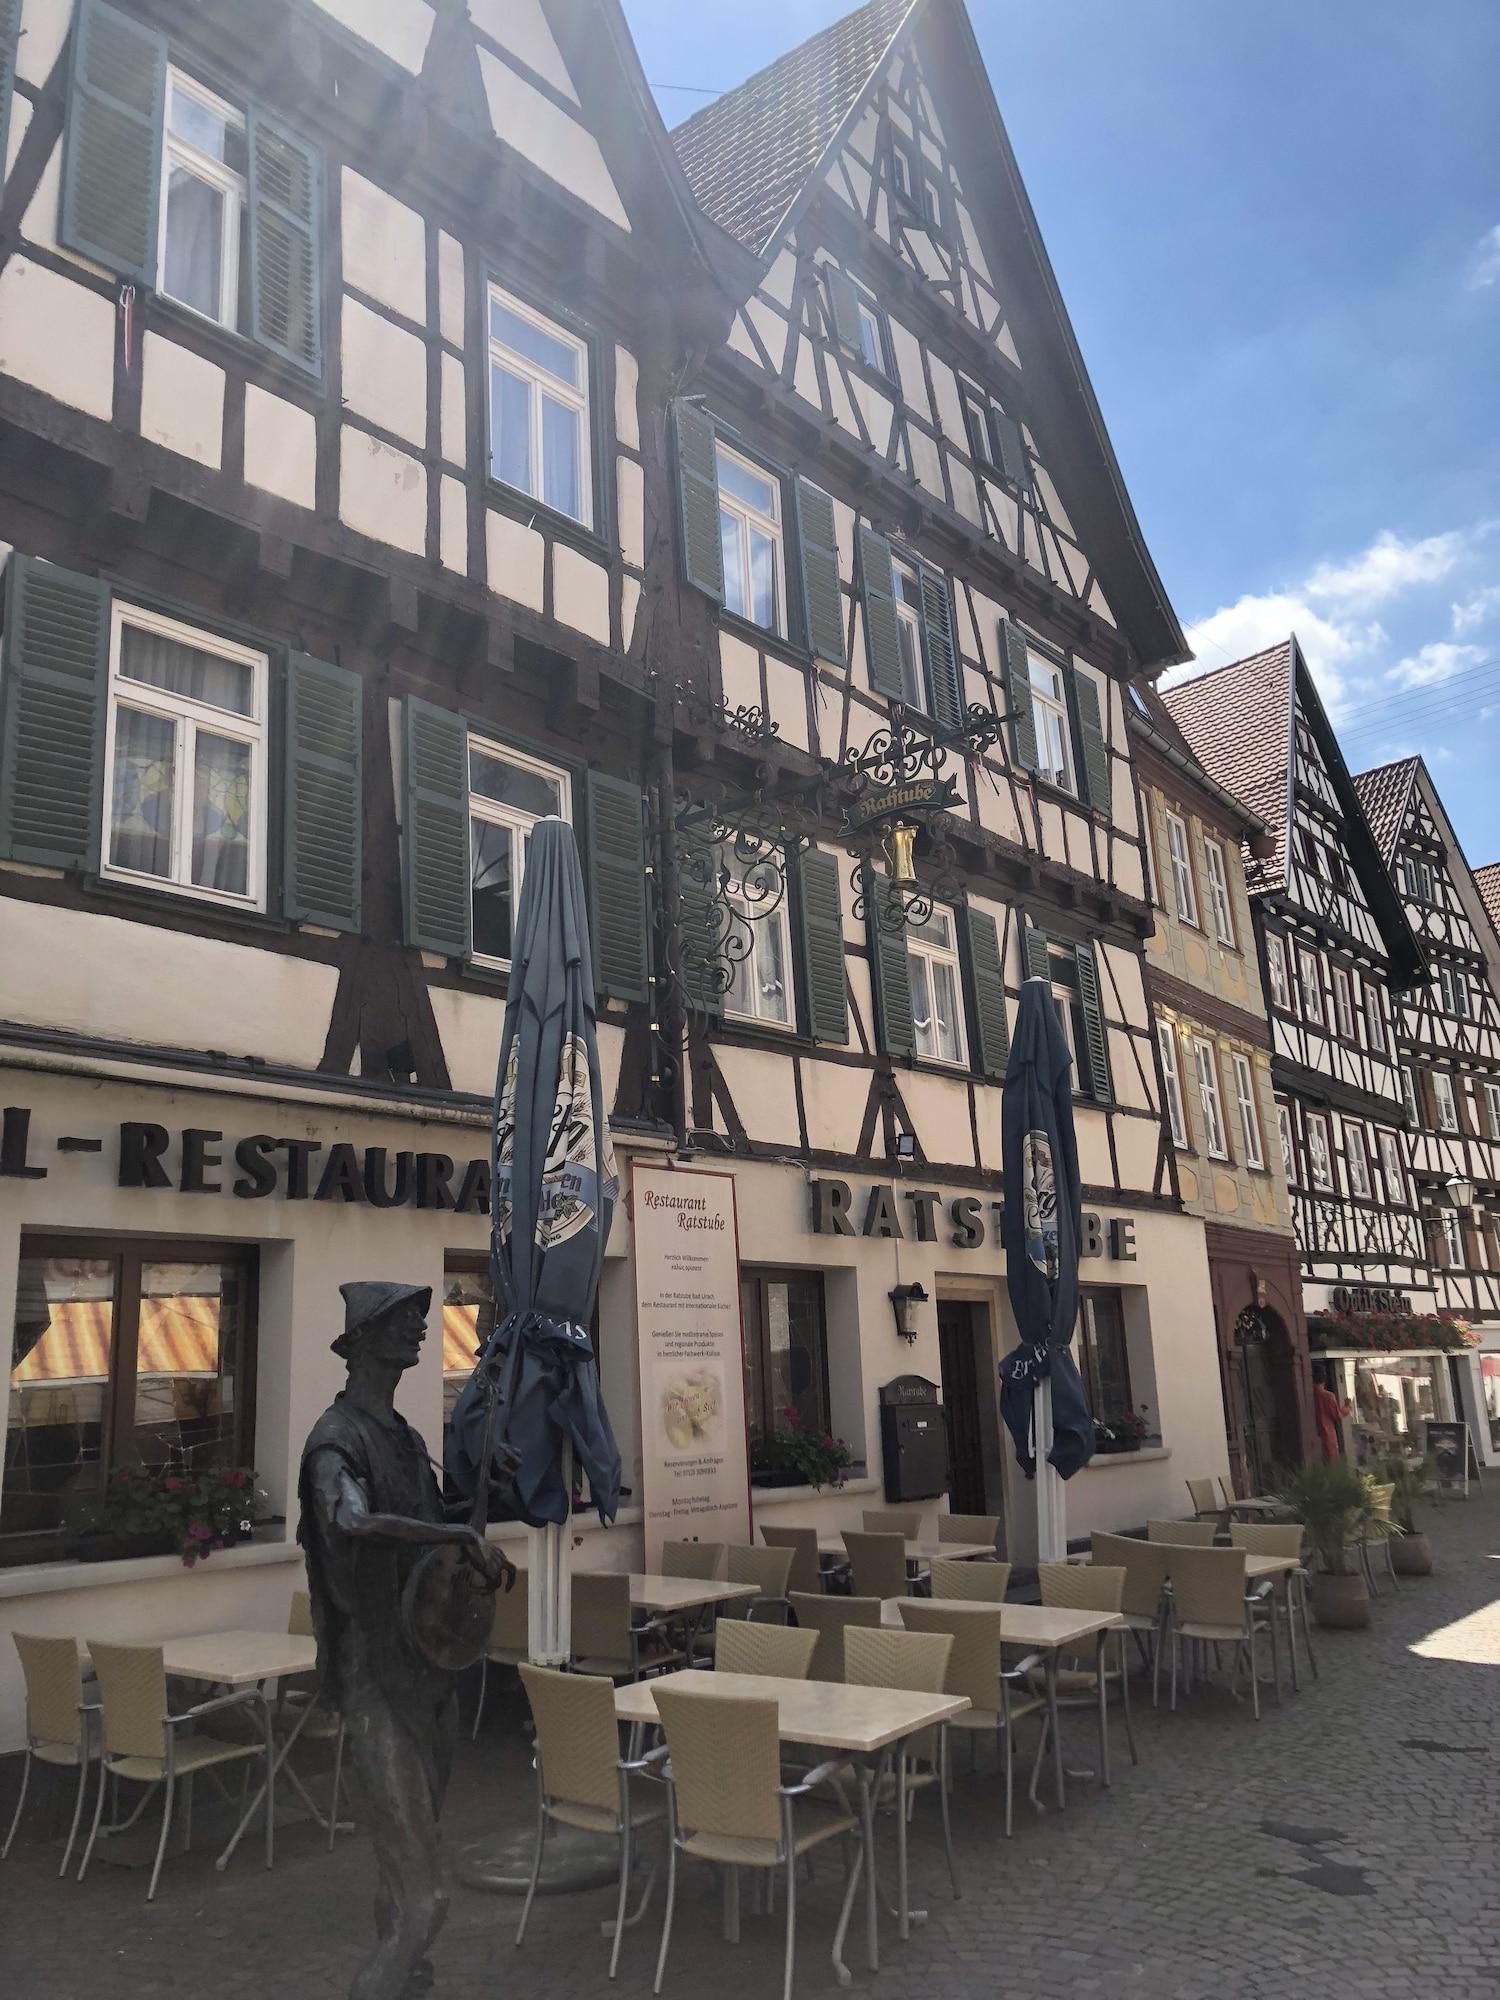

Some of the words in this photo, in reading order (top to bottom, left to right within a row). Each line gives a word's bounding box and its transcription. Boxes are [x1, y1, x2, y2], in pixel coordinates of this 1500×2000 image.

[644, 1190, 707, 1210] Restaurant
[677, 1212, 725, 1231] Ratstube
[812, 1178, 1137, 1262] RATSBE
[682, 1254, 709, 1262] Willkommen
[1333, 1287, 1377, 1313] Optik
[1378, 1288, 1412, 1314] Stein
